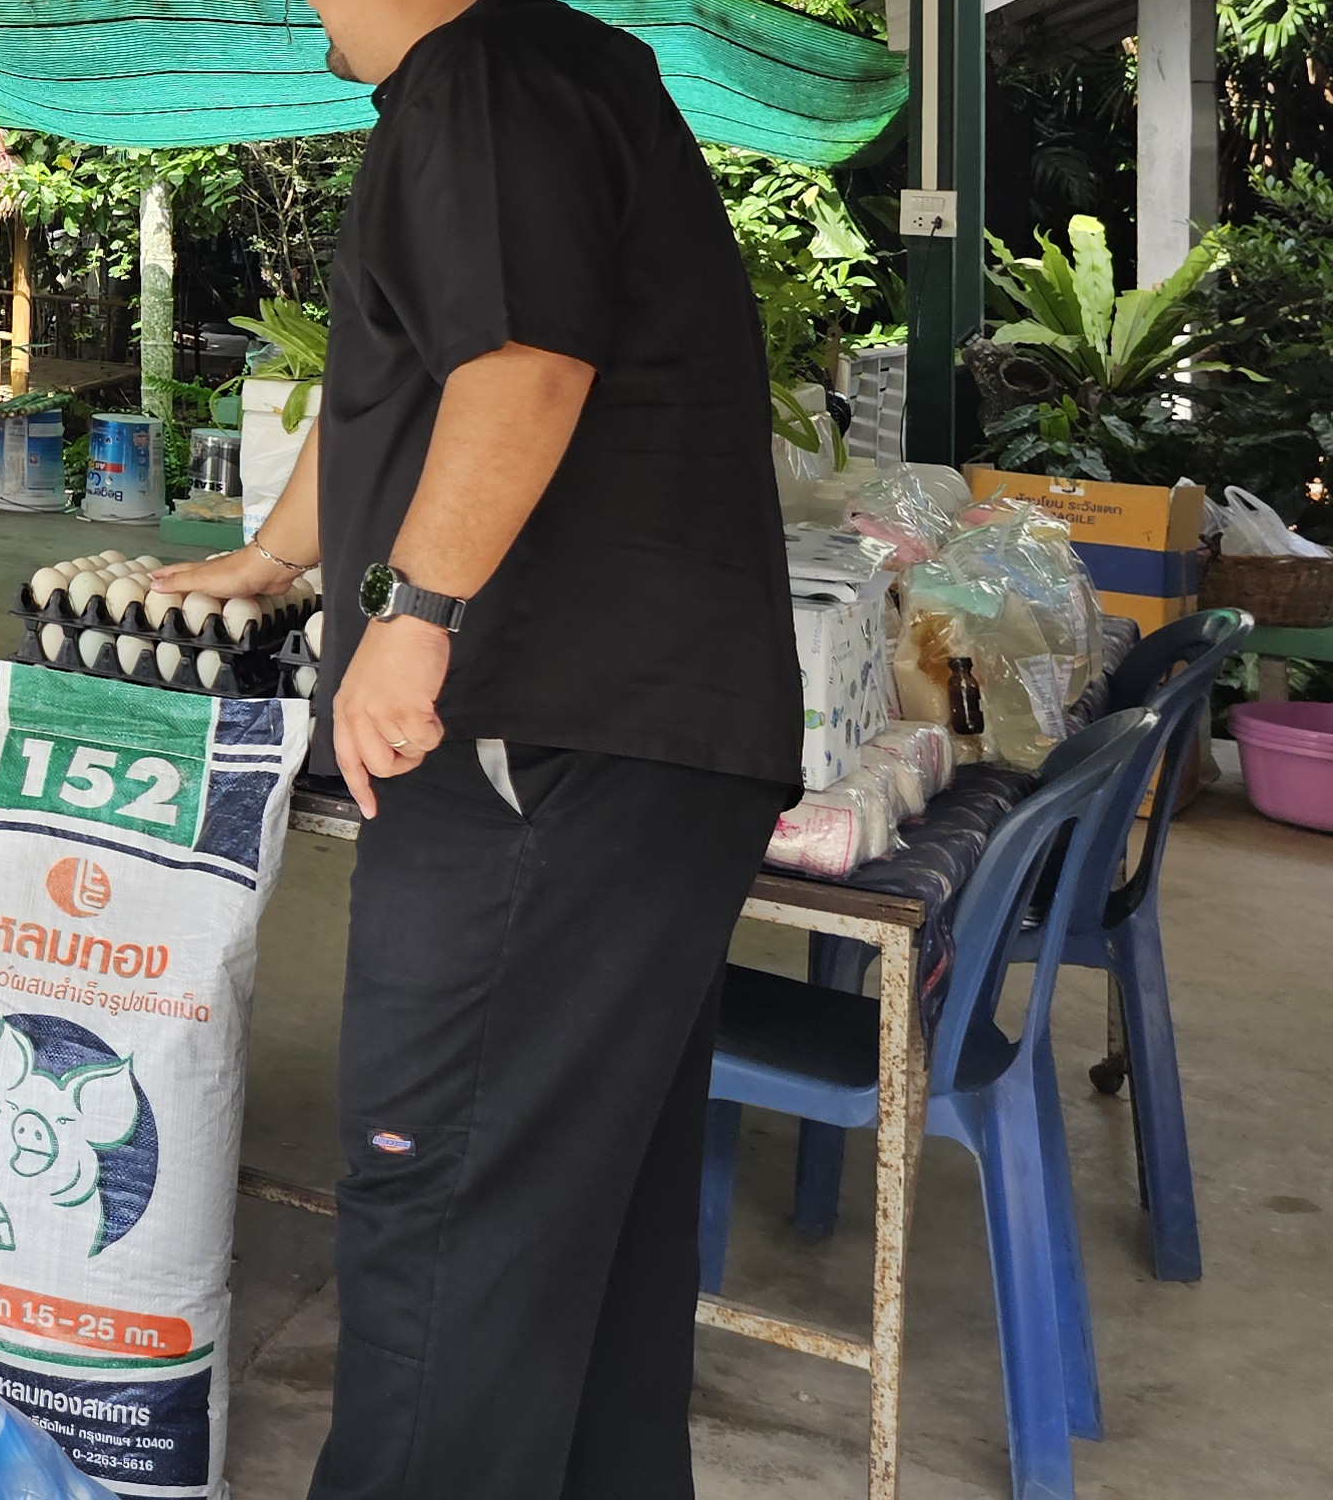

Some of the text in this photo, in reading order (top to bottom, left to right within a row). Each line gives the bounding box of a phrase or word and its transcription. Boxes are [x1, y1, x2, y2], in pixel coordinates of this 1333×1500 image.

[20, 738, 182, 826] 152
[123, 1325, 168, 1349] กก.
[79, 1429, 131, 1447] กรุงเทพฯ
[135, 1436, 175, 1450] 10400
[72, 1448, 154, 1471] 0-2263-5616
